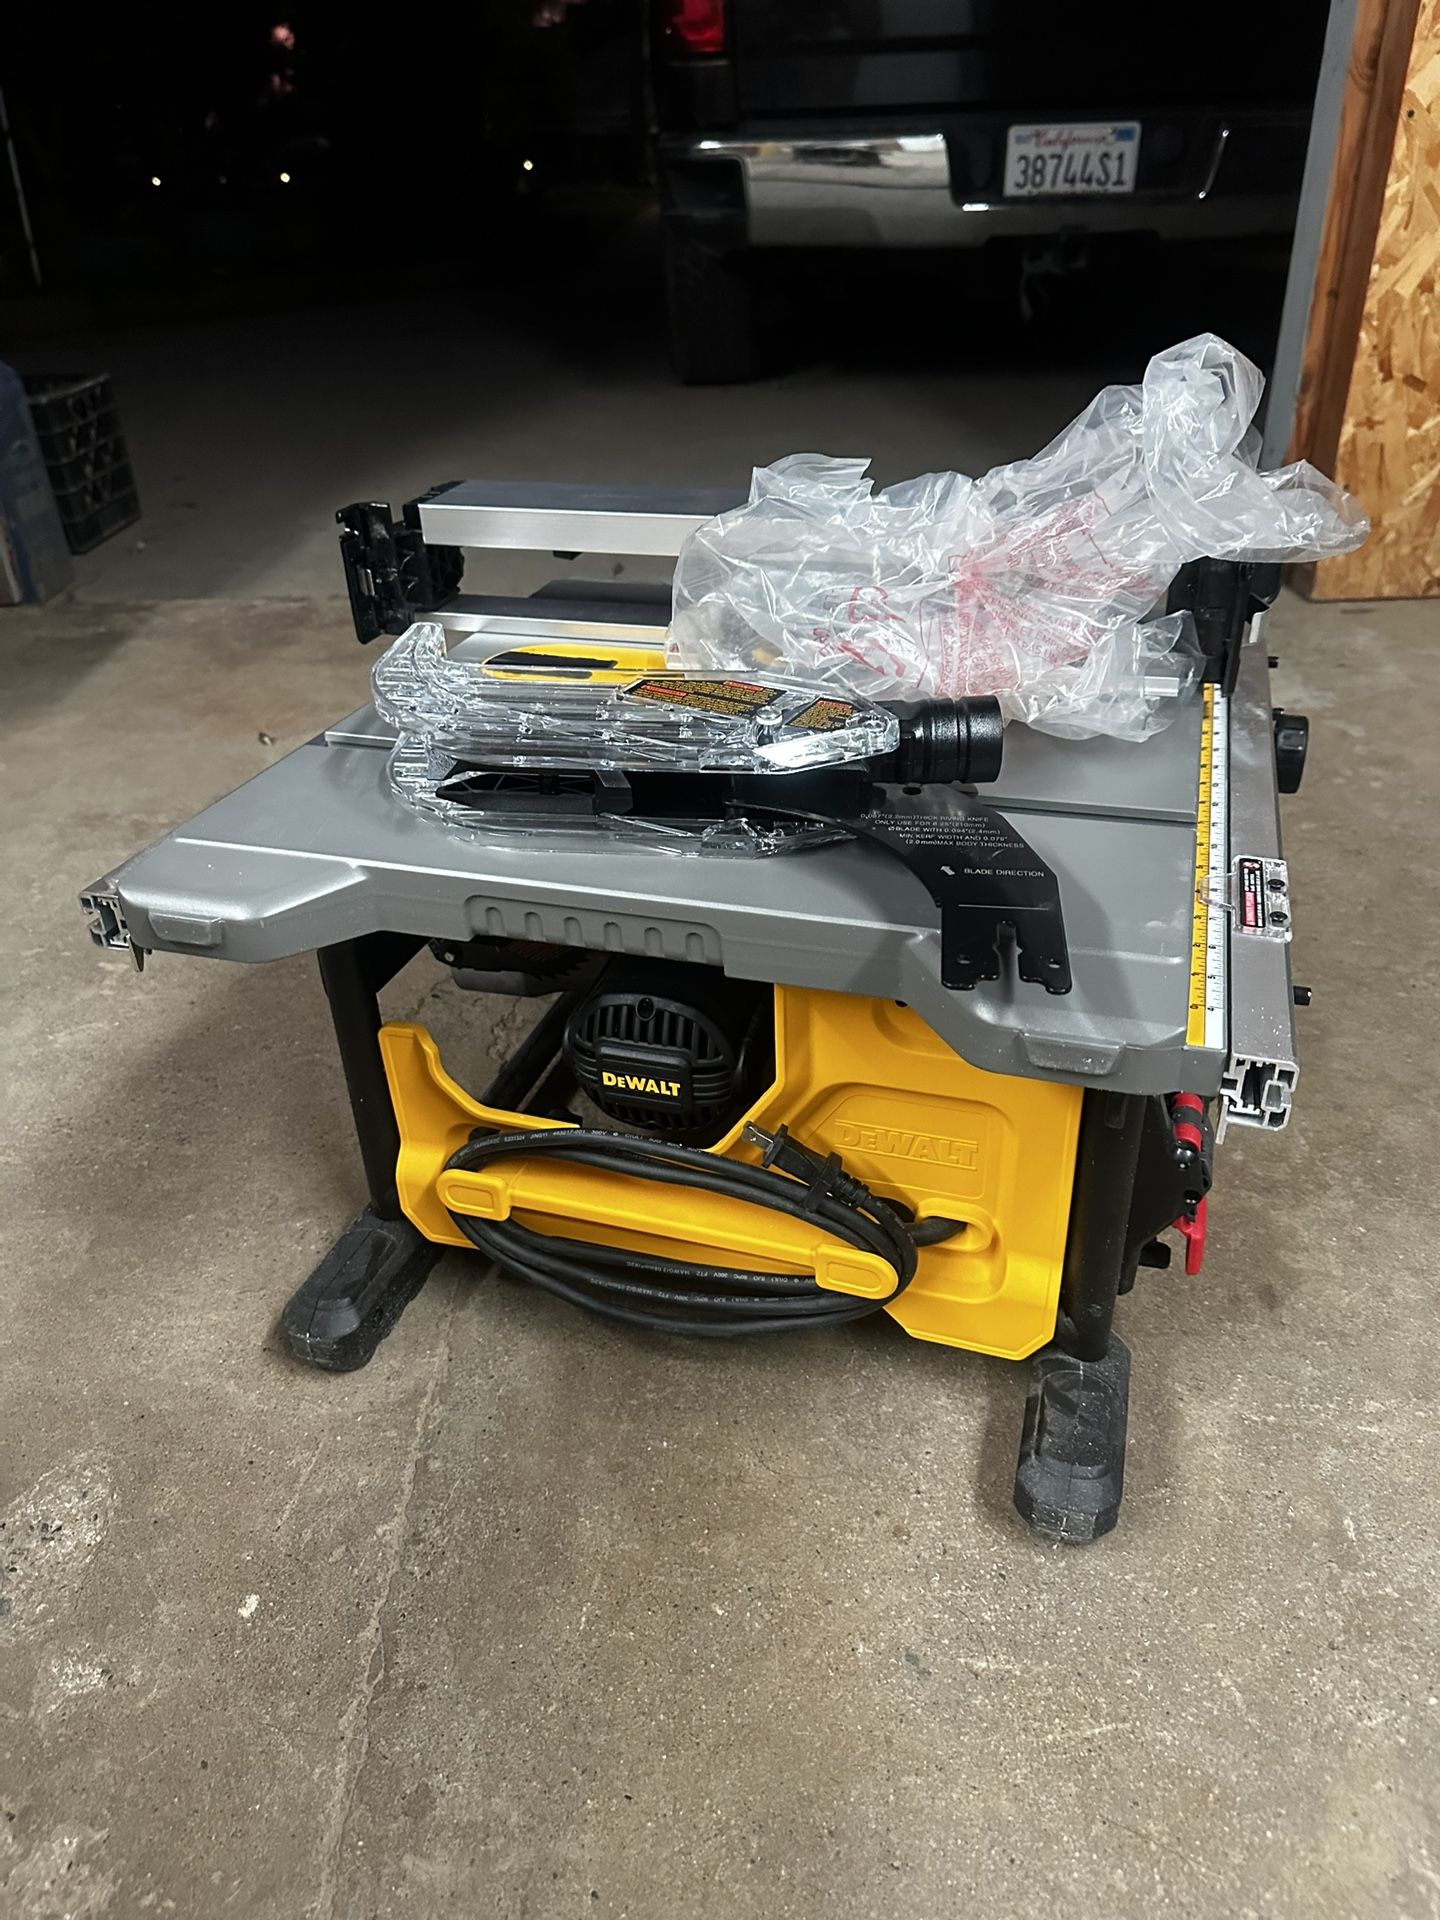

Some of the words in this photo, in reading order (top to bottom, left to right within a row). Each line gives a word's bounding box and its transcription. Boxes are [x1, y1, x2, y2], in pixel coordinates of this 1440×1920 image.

[1014, 152, 1127, 190] 38744S1
[964, 867, 993, 875] BLADE
[995, 869, 1045, 877] DIRECTION
